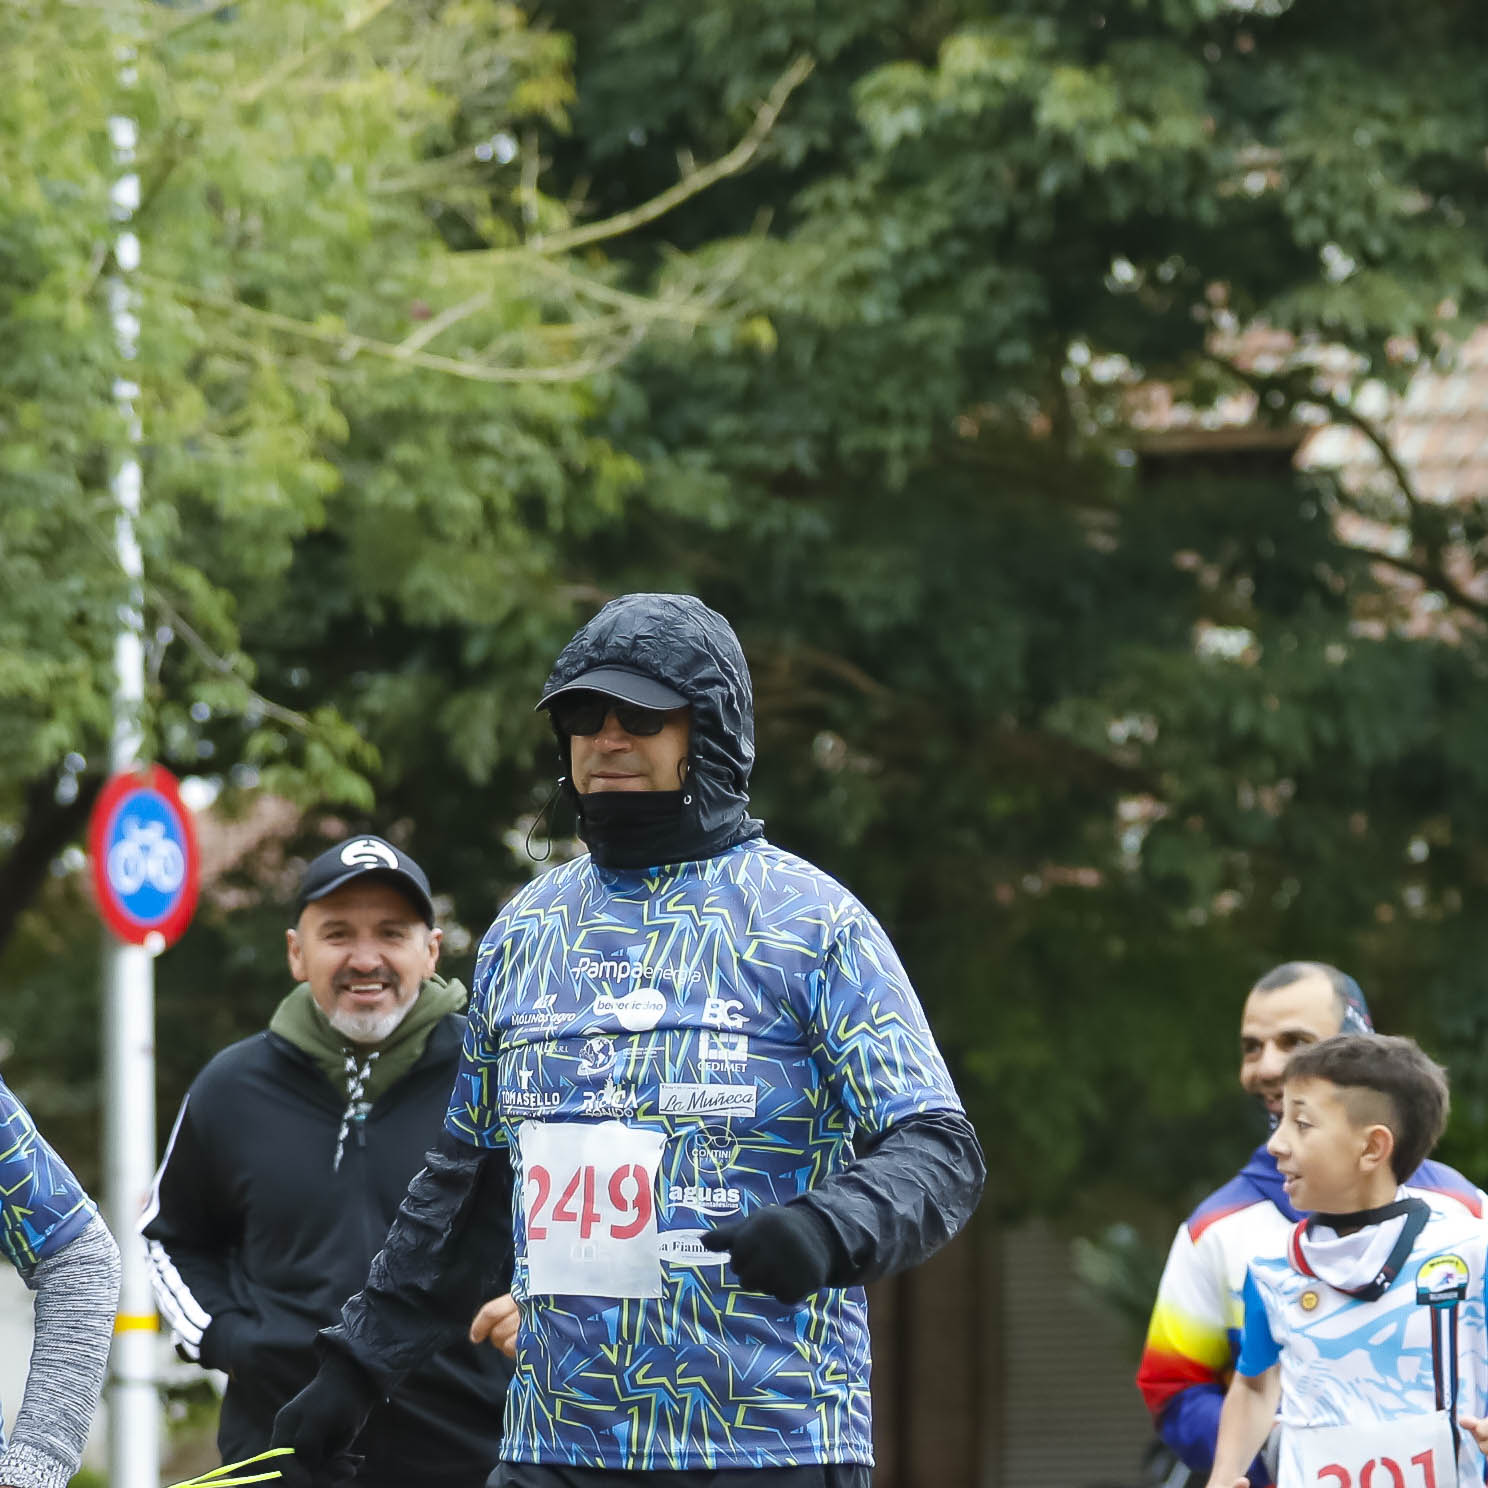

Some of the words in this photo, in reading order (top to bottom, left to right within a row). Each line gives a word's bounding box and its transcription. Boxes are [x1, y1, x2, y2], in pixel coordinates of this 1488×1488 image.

[502, 1090, 560, 1106] TOMASELLO
[661, 1094, 685, 1112] La
[686, 1089, 755, 1112] Muñeca
[692, 1148, 731, 1159] CONTINI
[527, 1164, 652, 1240] 249
[668, 1185, 741, 1205] aguas
